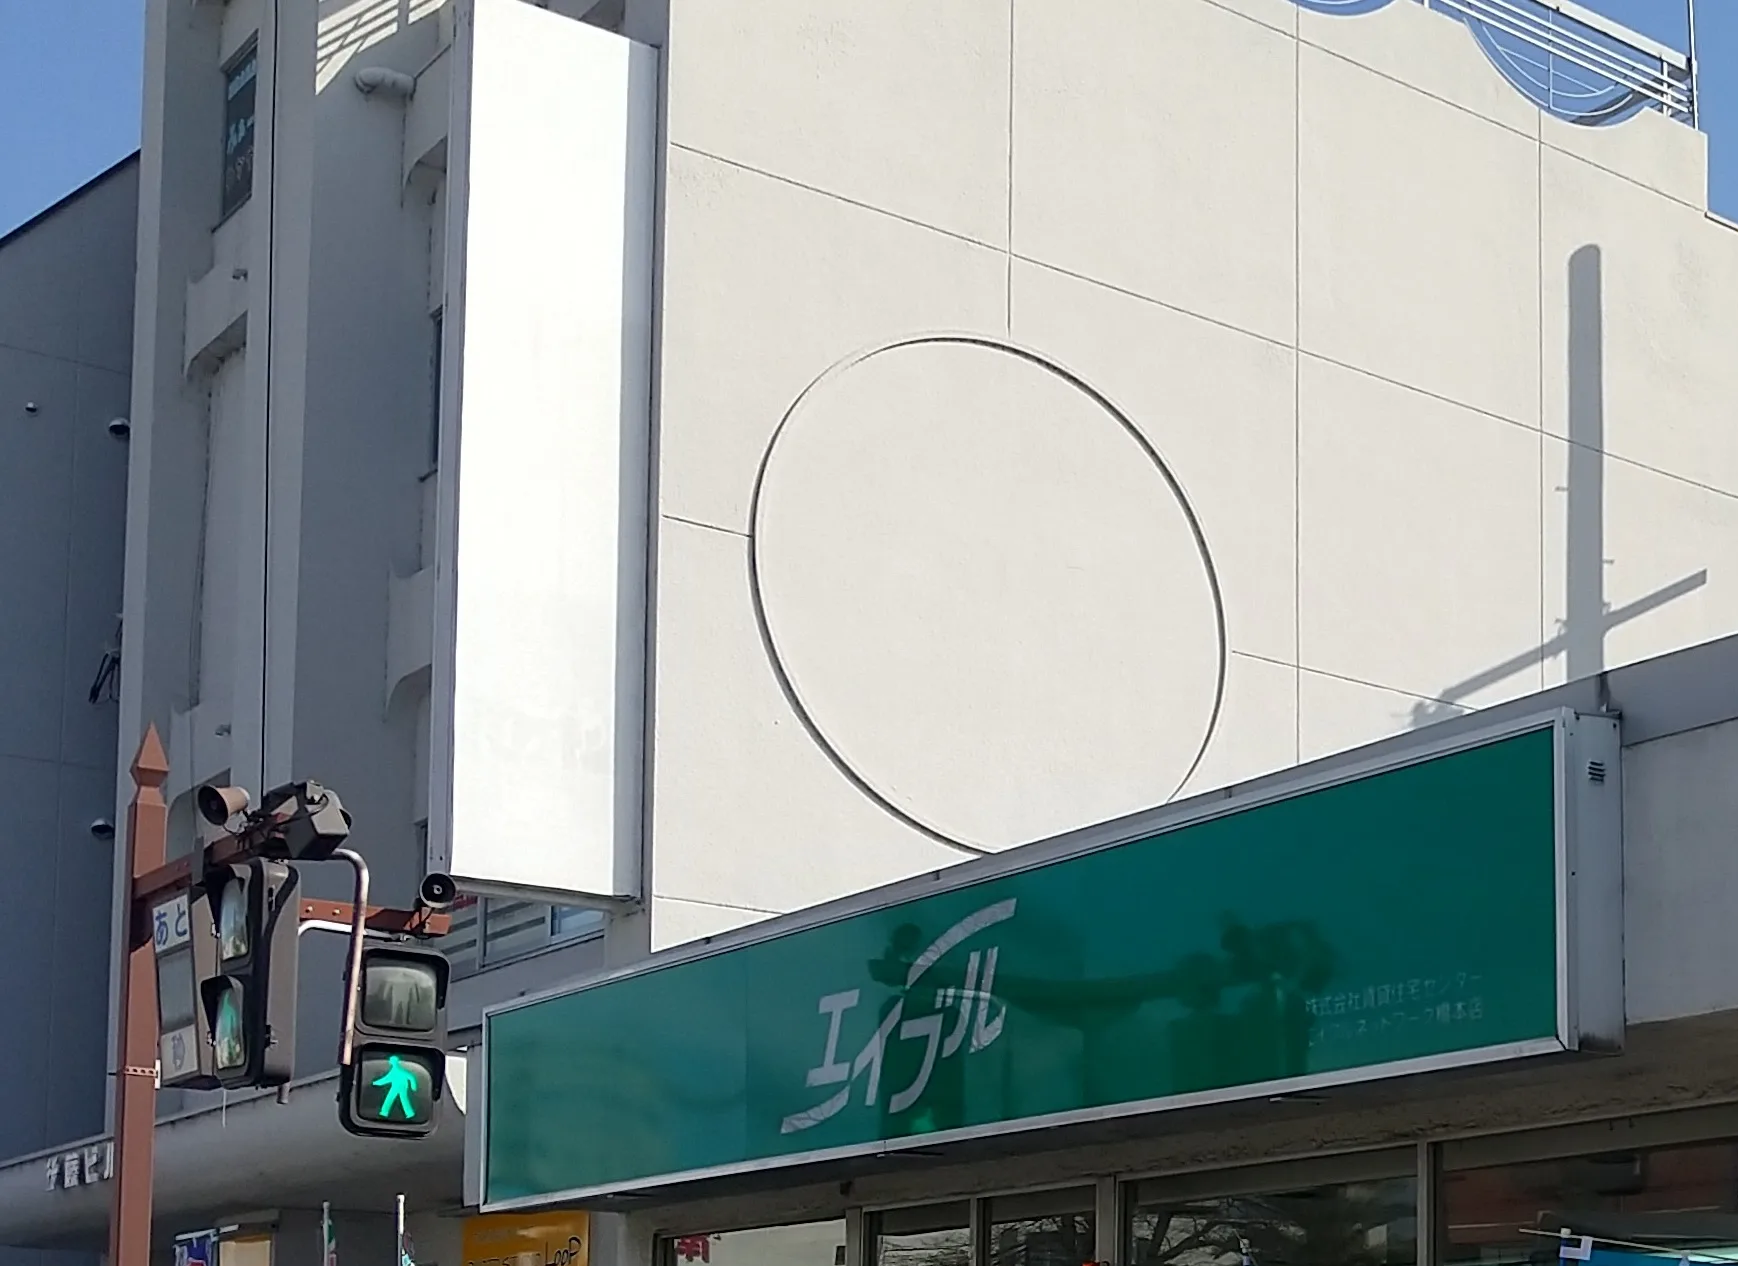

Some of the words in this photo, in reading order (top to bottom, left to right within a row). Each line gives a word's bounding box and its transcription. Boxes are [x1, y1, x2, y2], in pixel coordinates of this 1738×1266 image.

[155, 904, 188, 946] あと
[793, 922, 1012, 1128] エイブル
